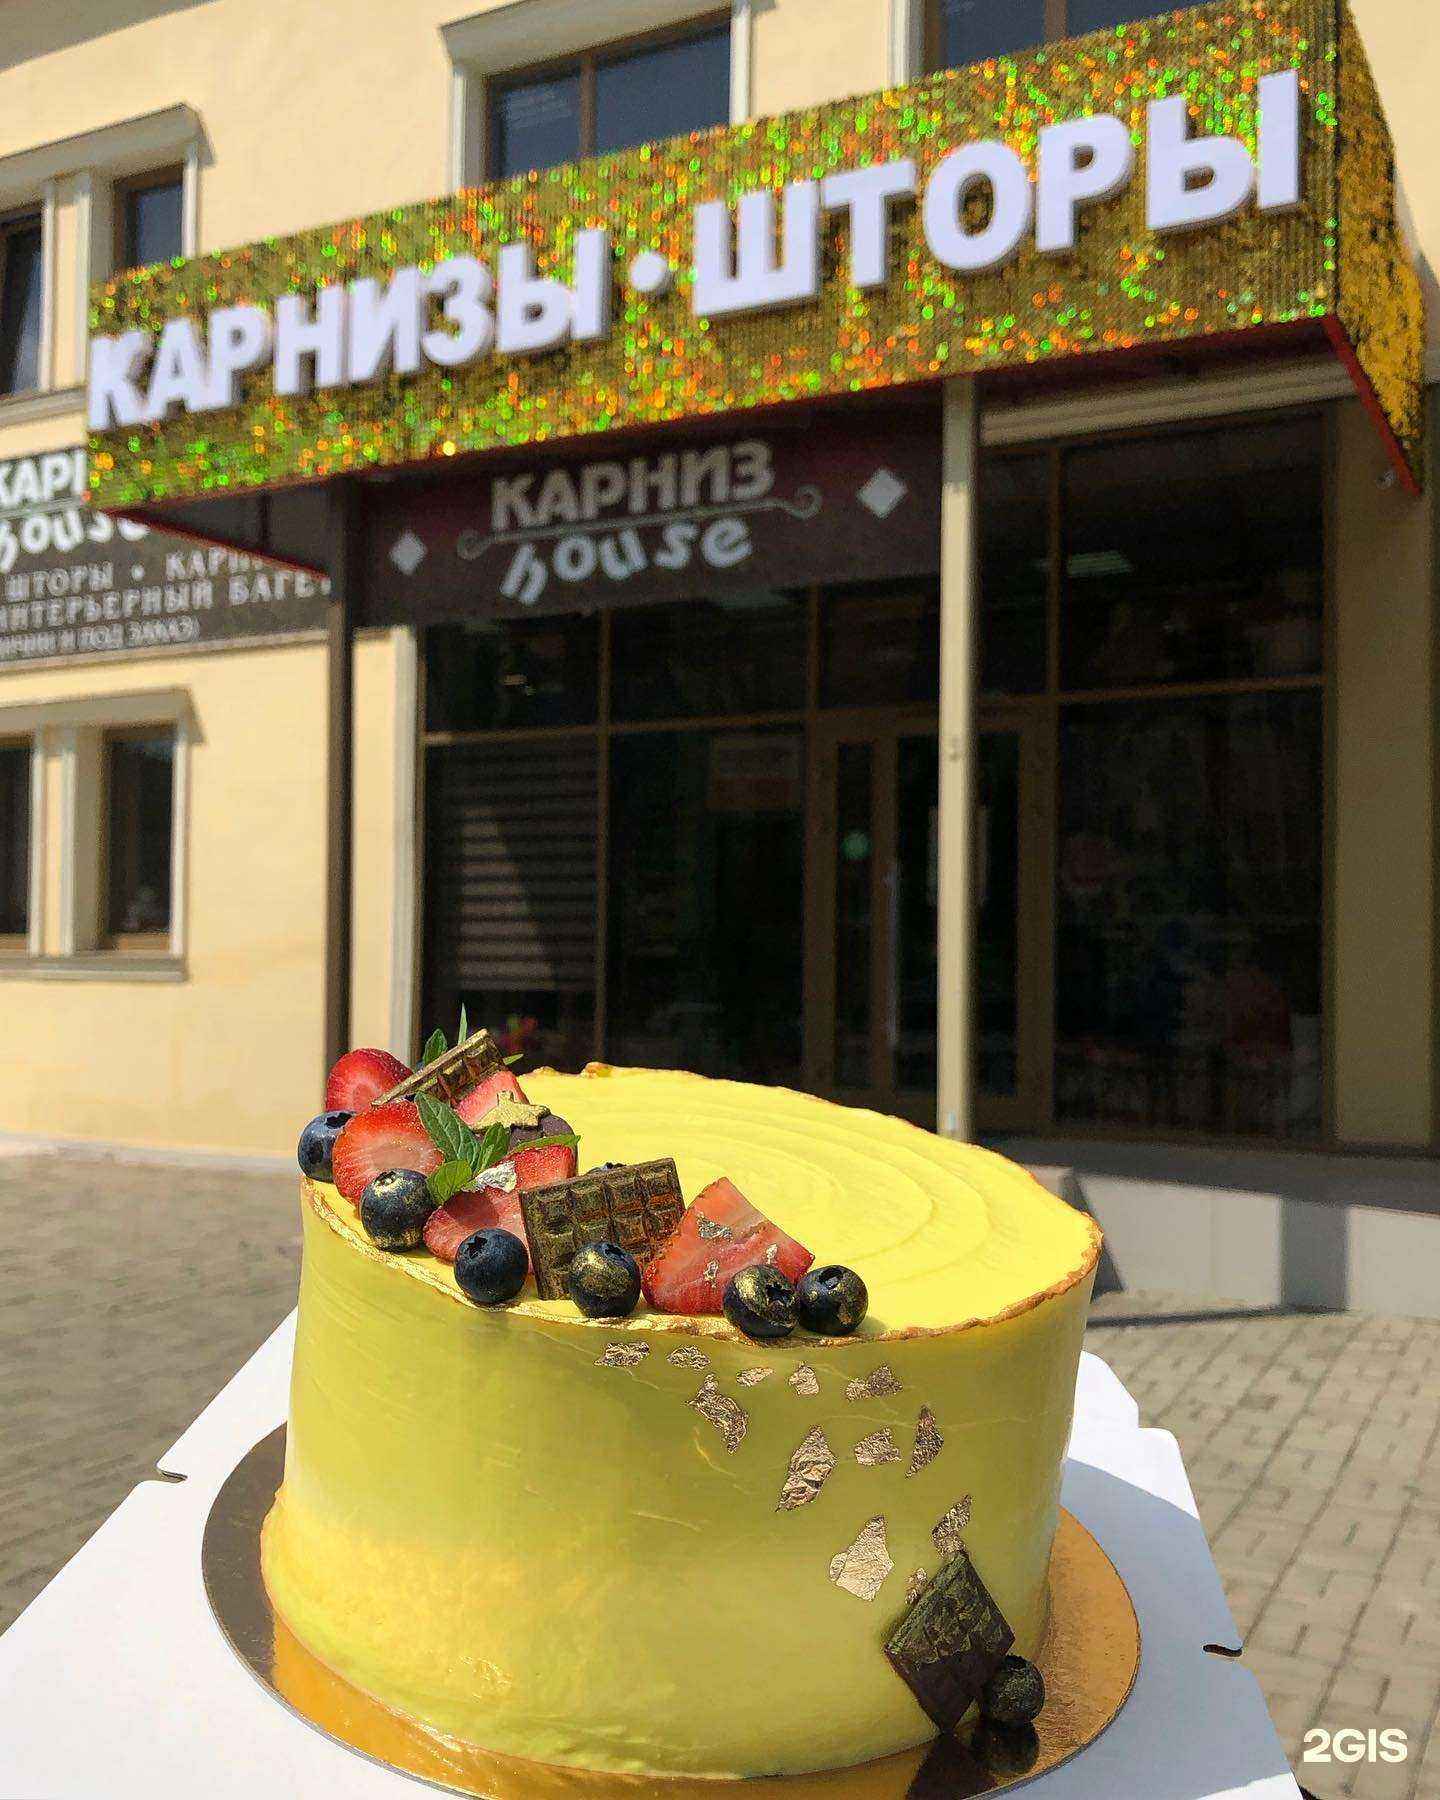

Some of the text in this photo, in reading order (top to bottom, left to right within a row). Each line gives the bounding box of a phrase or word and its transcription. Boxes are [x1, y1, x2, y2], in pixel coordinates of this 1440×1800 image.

[88, 69, 1300, 430] КАРНИЗЫ ШТОРЫ
[491, 439, 775, 531] КАРНИЗ
[6, 561, 114, 603] ШТОРЫ
[499, 516, 754, 606] house
